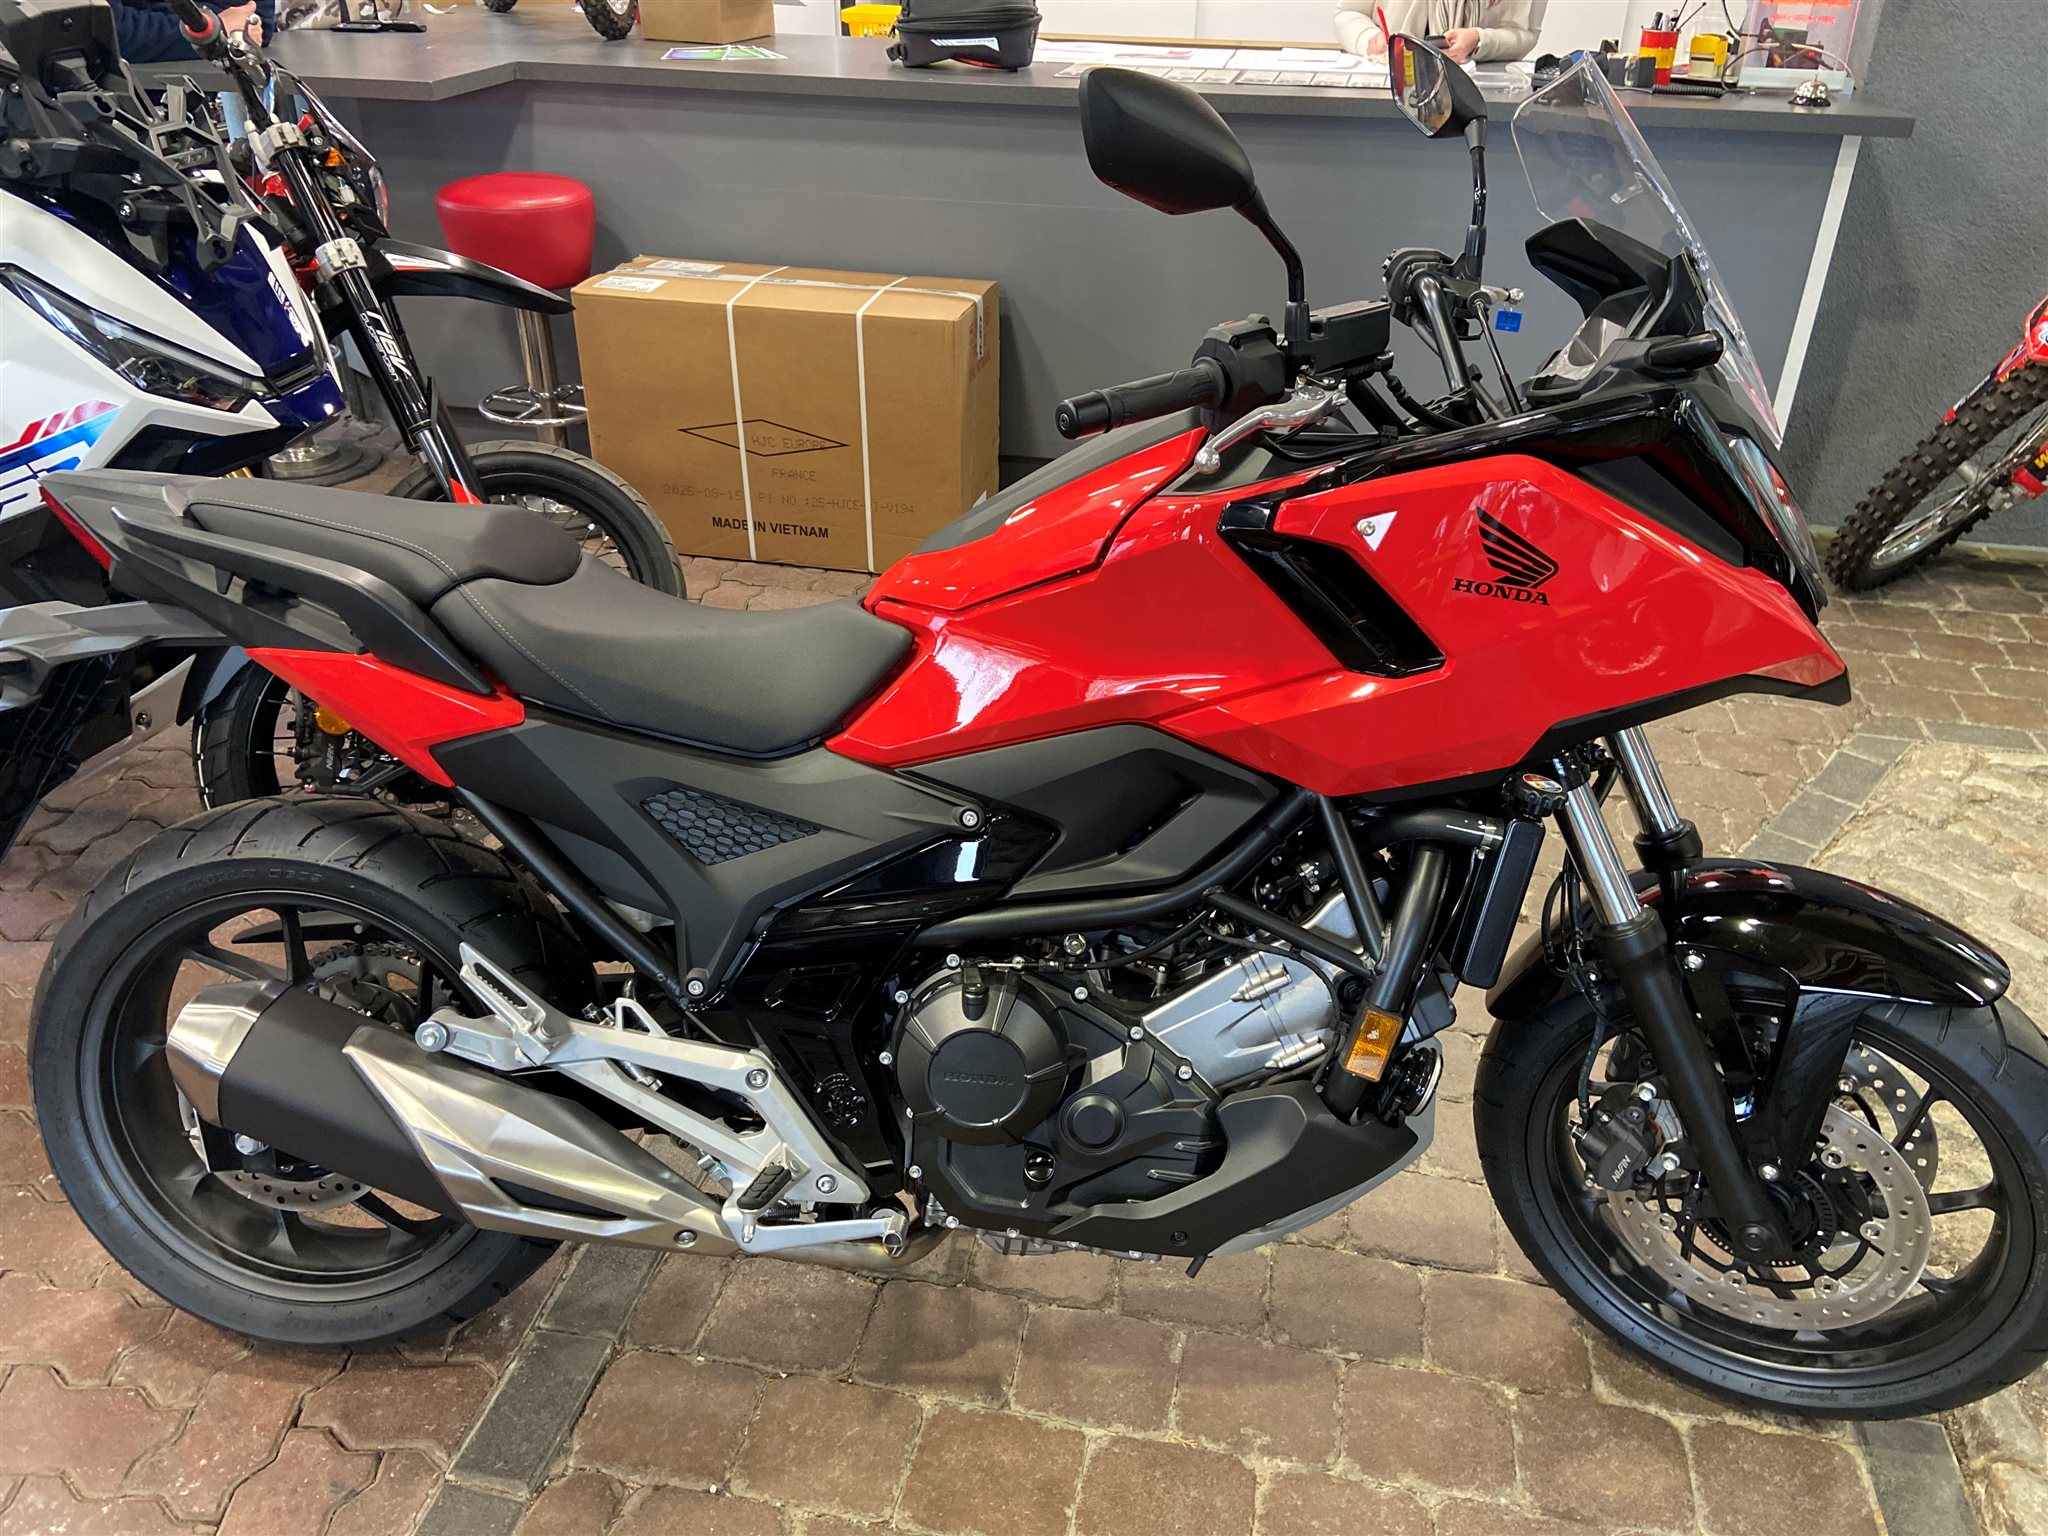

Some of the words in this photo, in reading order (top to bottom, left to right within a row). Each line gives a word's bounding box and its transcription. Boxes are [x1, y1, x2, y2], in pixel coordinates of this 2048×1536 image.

[751, 434, 777, 448] HJC
[782, 437, 826, 450] EUROPE
[771, 467, 817, 482] FRANCE
[712, 516, 749, 531] MADE
[753, 521, 767, 533] IN
[769, 522, 829, 539] VIETNAM
[1452, 578, 1550, 606] HONDA
[944, 1072, 1015, 1086] HONDA
